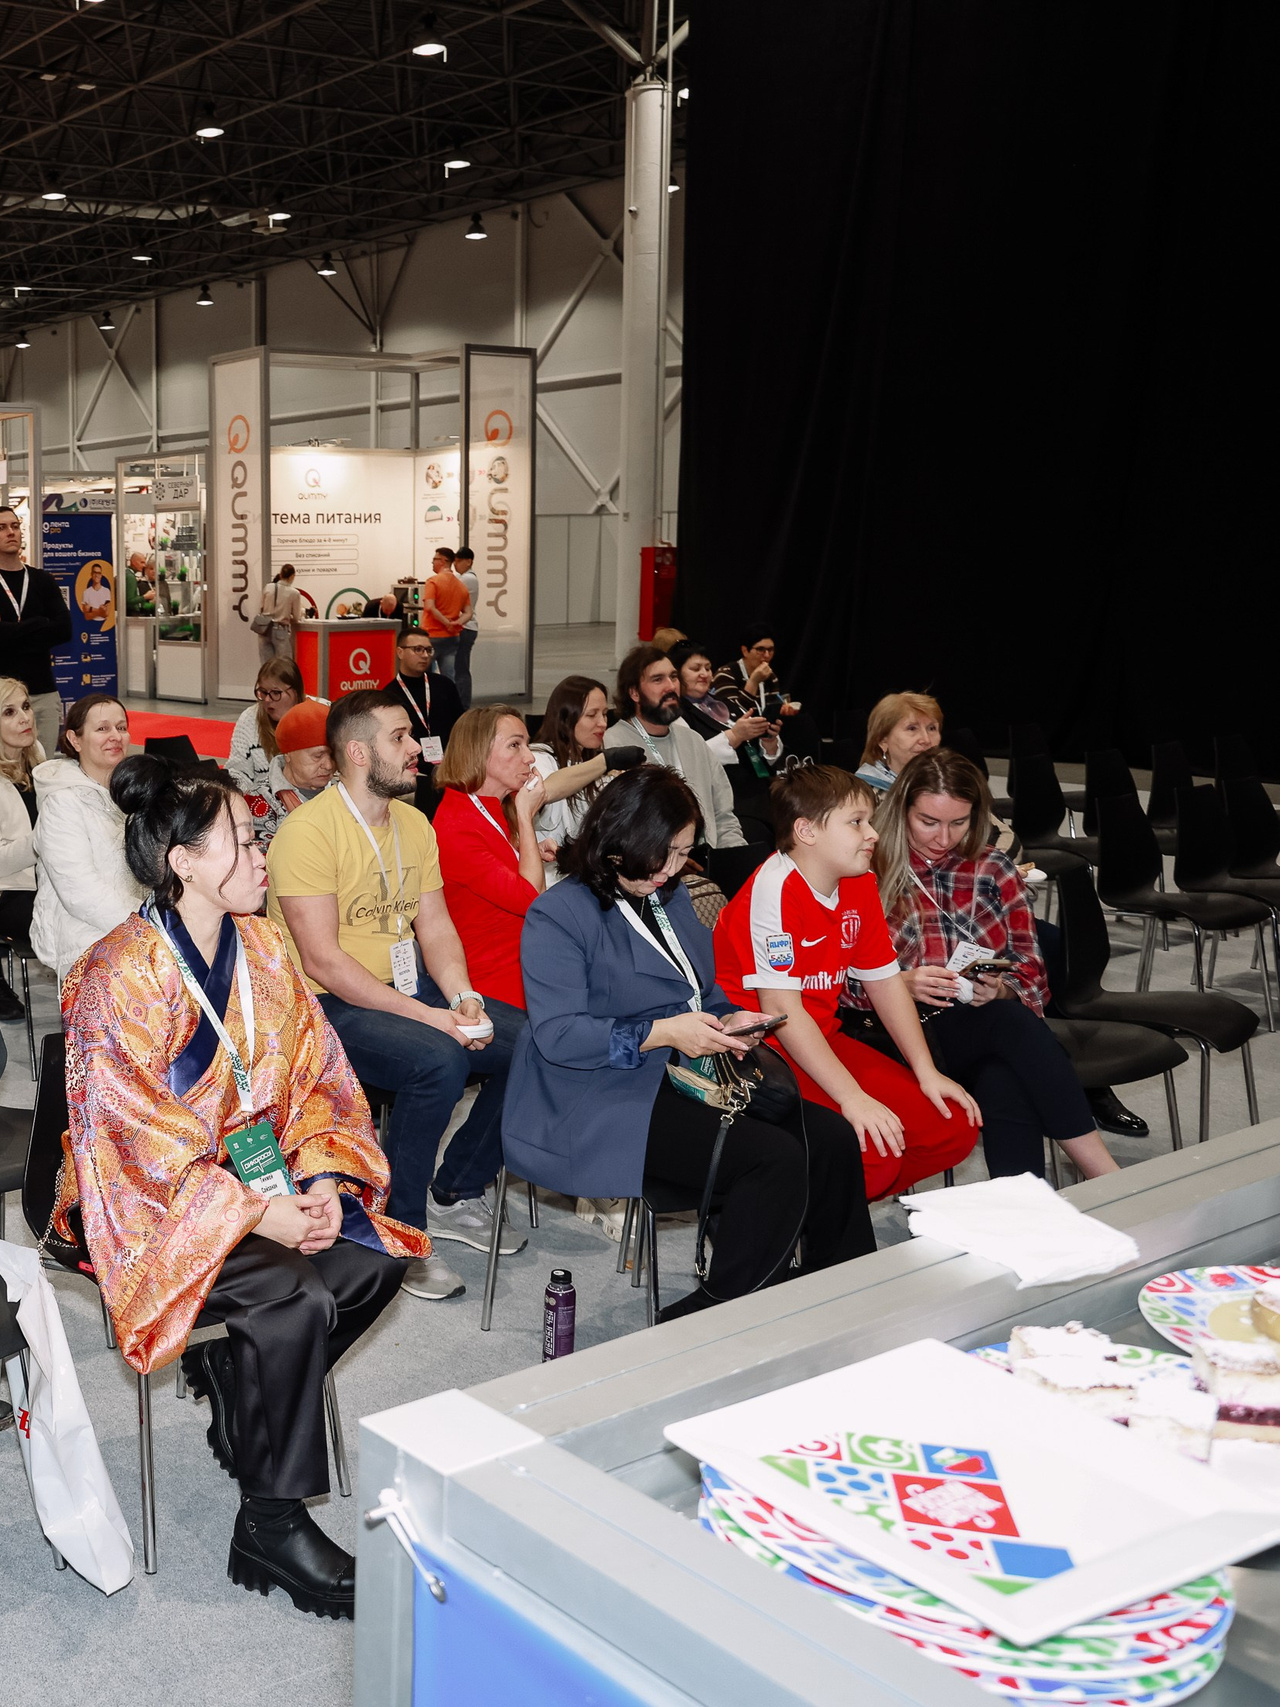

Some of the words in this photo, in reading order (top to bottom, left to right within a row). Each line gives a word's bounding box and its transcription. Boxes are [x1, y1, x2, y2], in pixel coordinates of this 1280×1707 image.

[172, 488, 190, 500] ДАР
[316, 513, 381, 524] питания
[43, 542, 73, 550] Продукты
[356, 904, 392, 918] Calvin
[393, 897, 420, 912] Klein
